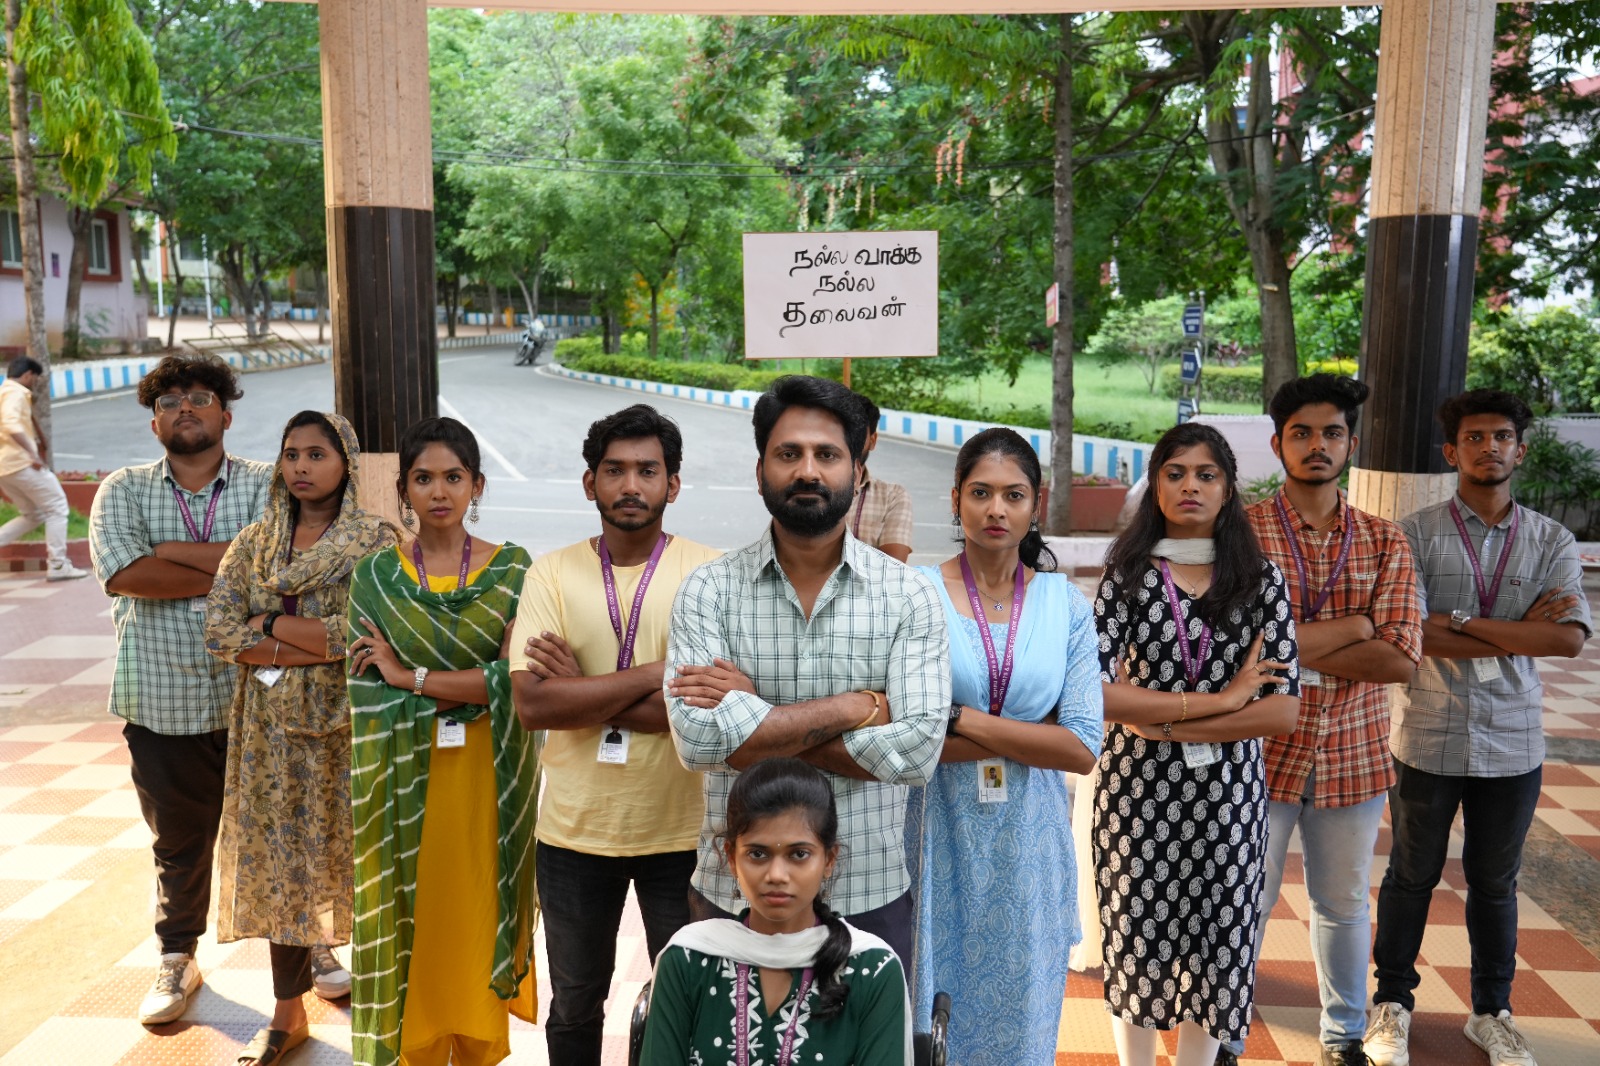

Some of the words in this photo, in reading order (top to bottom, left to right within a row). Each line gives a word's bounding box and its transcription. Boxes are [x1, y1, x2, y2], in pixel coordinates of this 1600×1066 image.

[789, 244, 849, 277] நல்ல
[854, 243, 922, 265] வாக்கு
[813, 270, 875, 296] நல்ல
[779, 296, 906, 338] தலைவன்
[738, 969, 747, 995] (NASC)
[738, 996, 746, 1033] COLLEGE
